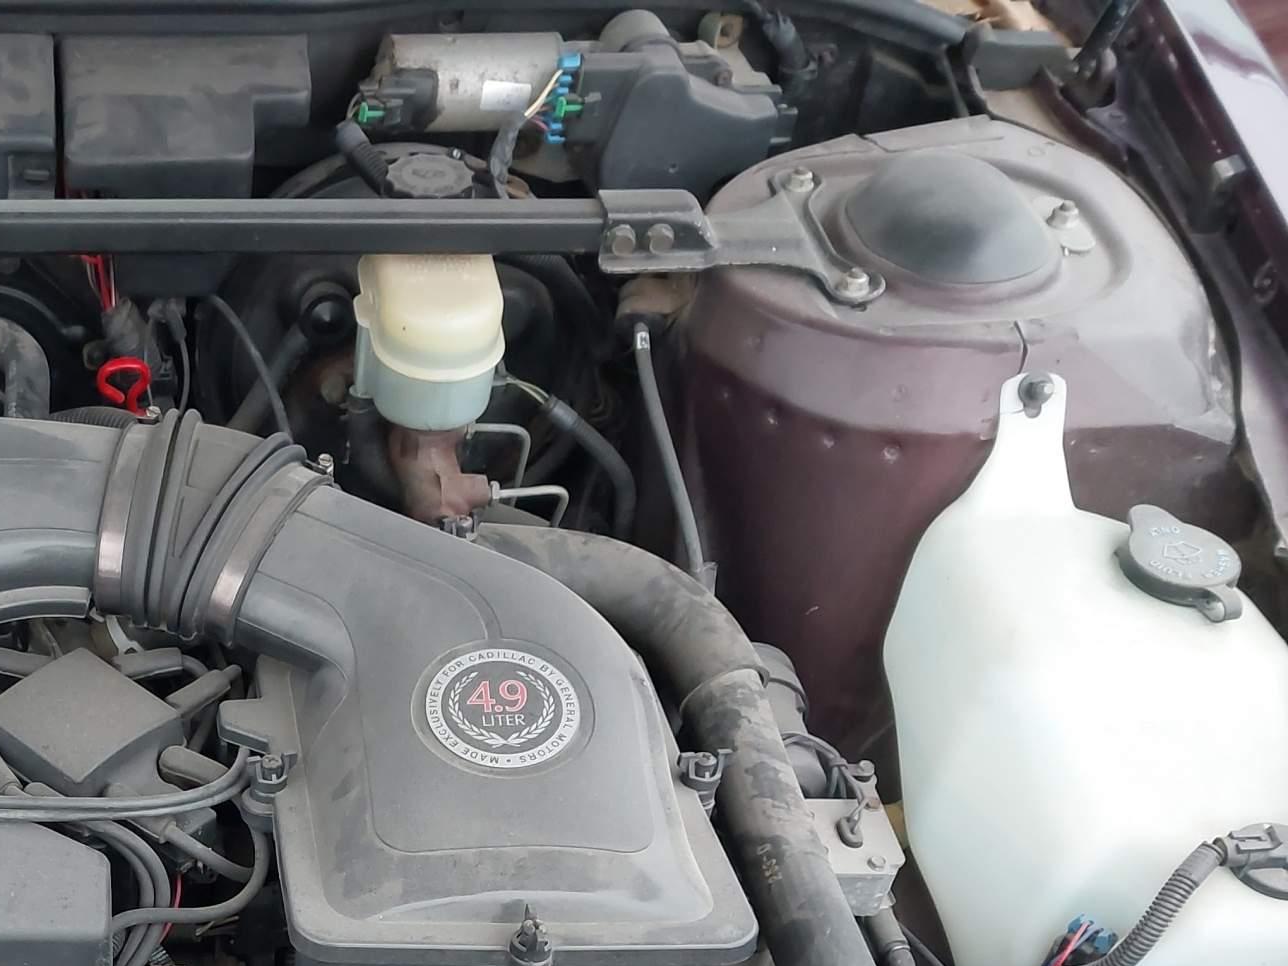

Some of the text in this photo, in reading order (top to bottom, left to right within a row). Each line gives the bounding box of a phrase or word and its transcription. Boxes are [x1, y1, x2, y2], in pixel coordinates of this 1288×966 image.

[429, 651, 576, 764] MADE EXCLUSIVELY FOR CADILLAC BY GENERAL MOTORS
[467, 680, 528, 713] 4.9
[482, 714, 526, 727] LITER
